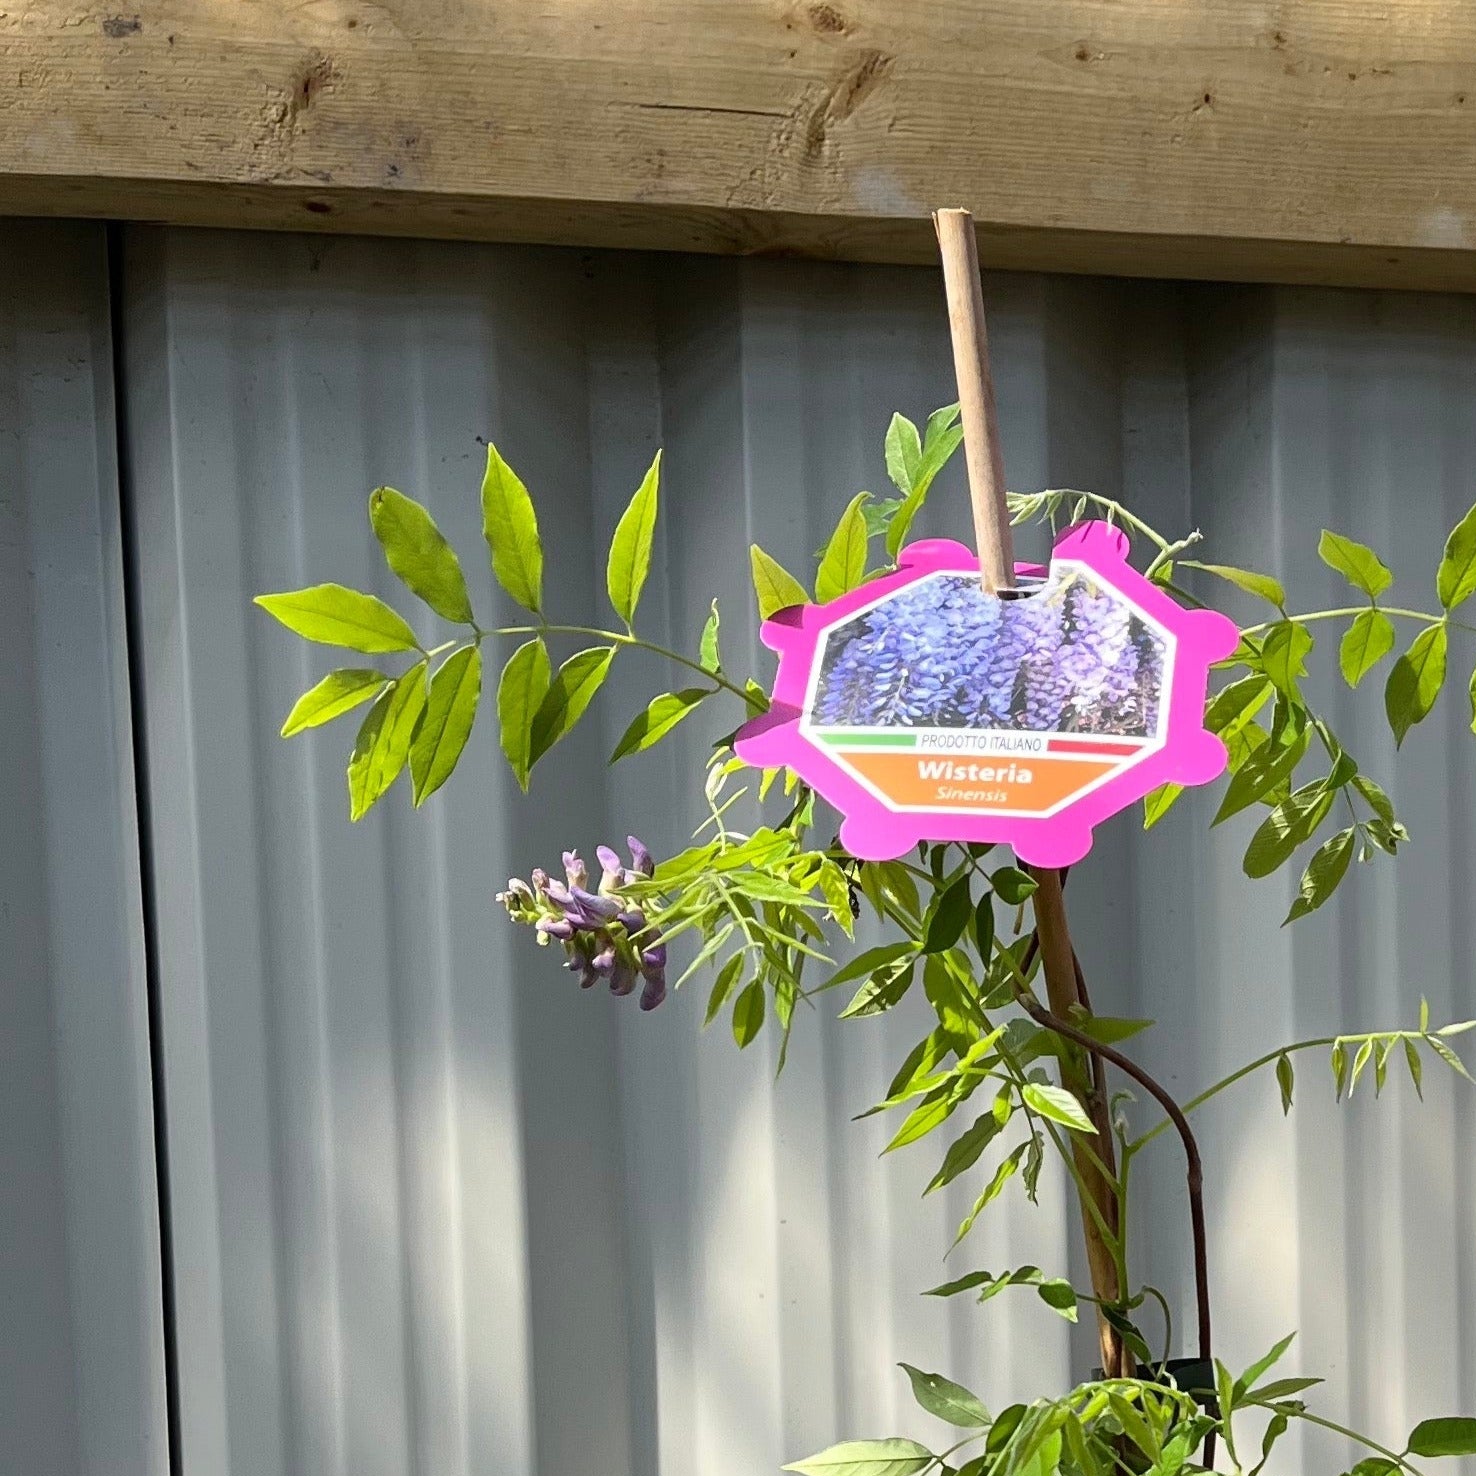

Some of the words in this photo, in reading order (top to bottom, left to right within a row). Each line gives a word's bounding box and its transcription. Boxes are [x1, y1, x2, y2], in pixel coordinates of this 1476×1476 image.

[920, 734, 987, 749] PRODOTTO
[990, 736, 1042, 751] ITALIANO
[917, 760, 1033, 784] Wisteria
[936, 786, 1008, 802] Sinensis
